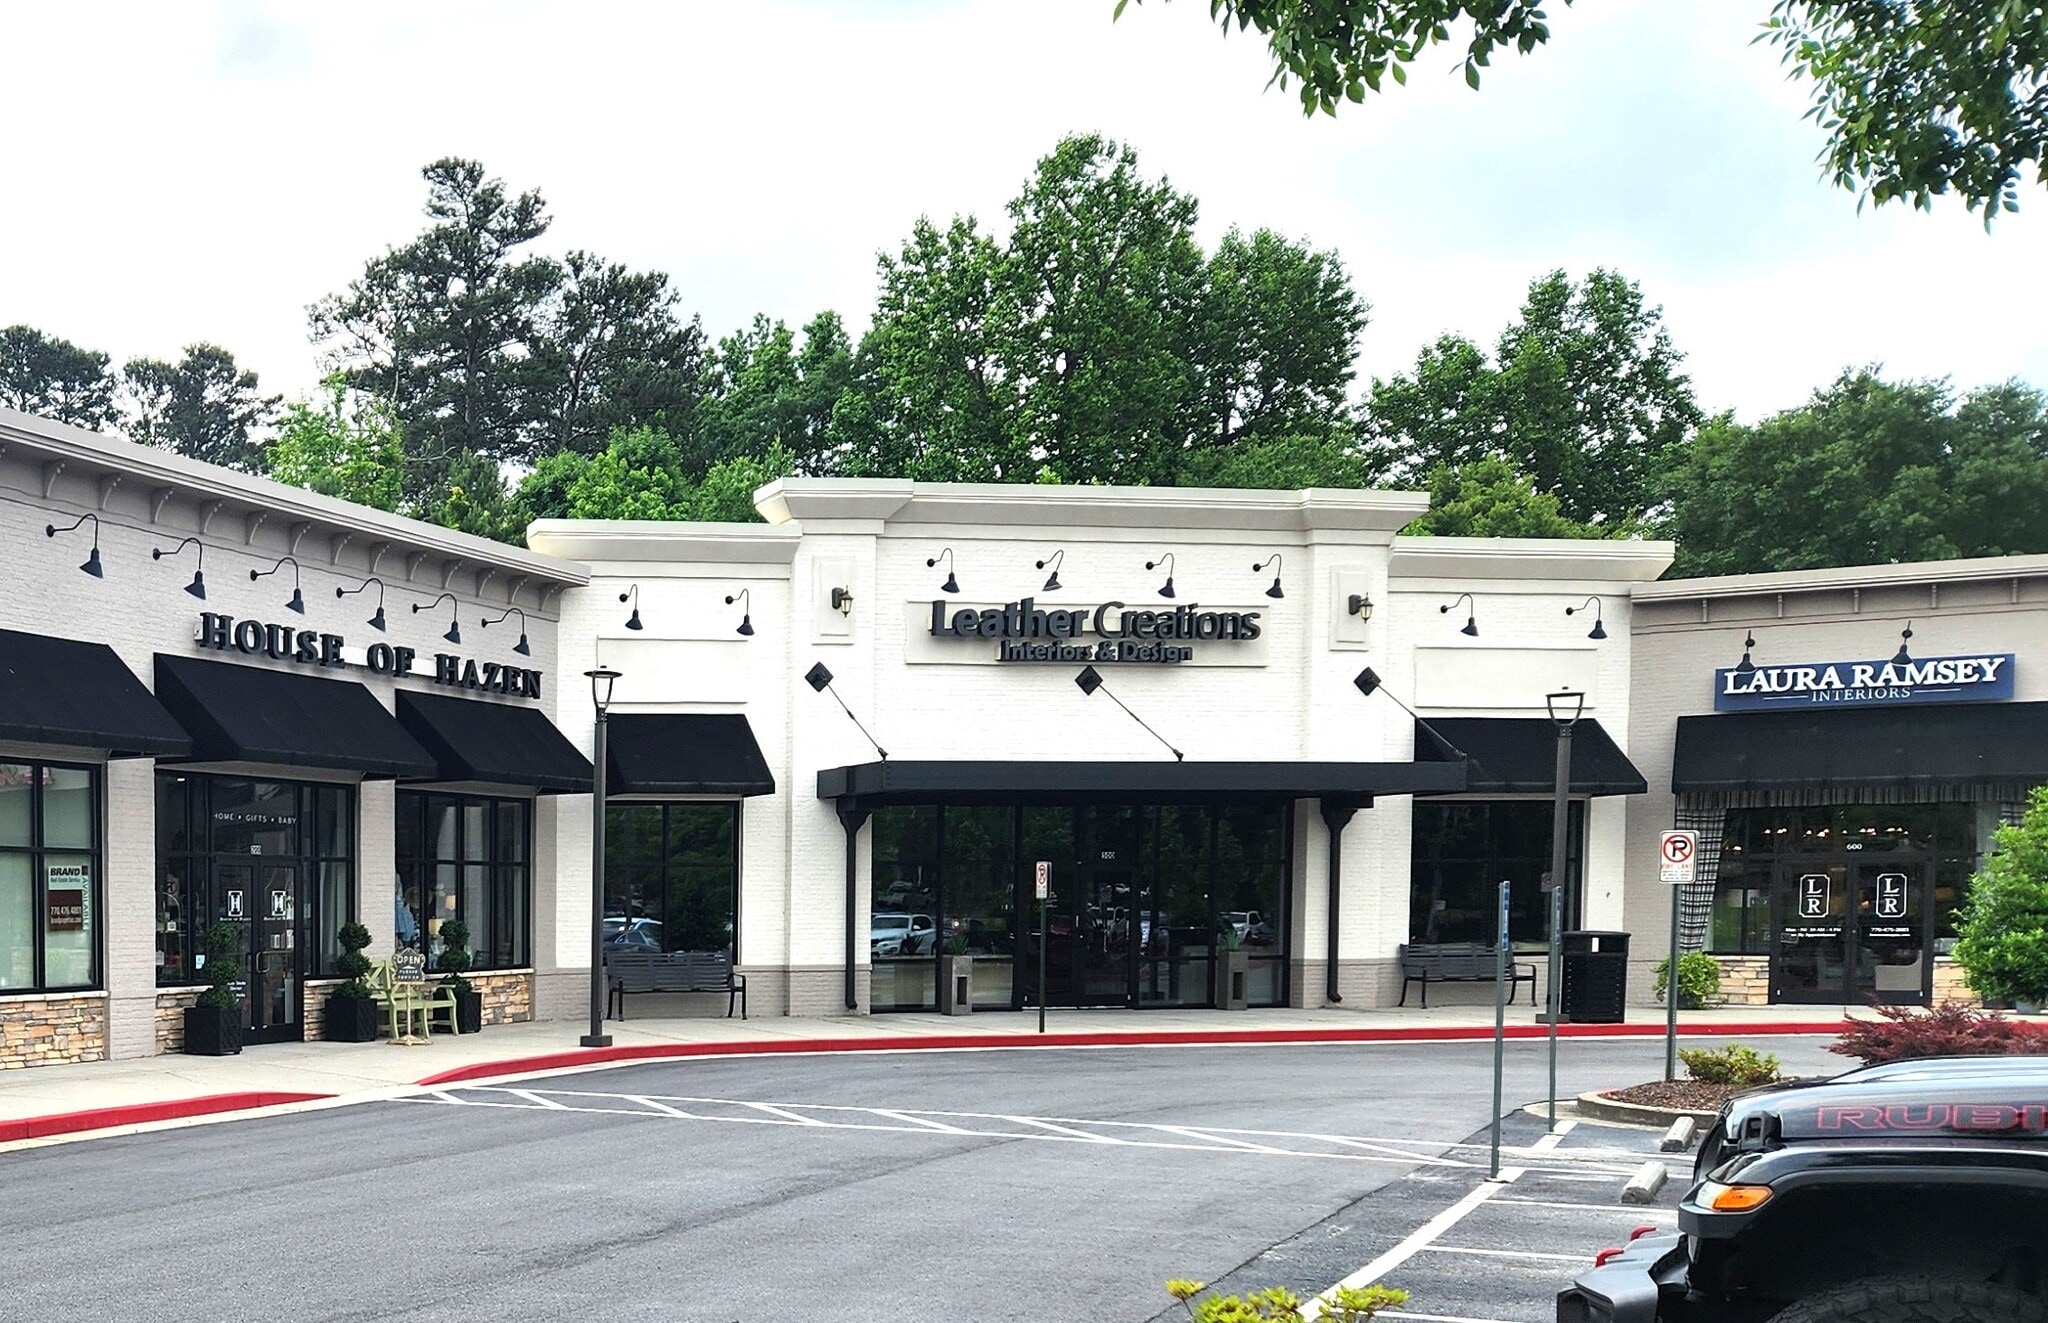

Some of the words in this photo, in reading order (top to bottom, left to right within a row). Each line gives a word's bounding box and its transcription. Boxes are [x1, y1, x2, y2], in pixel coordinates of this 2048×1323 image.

[931, 597, 1089, 637] Leather
[1093, 601, 1261, 640] Creations
[200, 612, 345, 669] HOUSE
[367, 643, 415, 677] OF
[434, 653, 542, 699] HAZEN
[999, 640, 1093, 661] Interiors
[1095, 640, 1117, 661] &
[1117, 640, 1193, 664] Design
[1723, 665, 1844, 694] LAURA
[1851, 657, 2005, 689] RAMSEY
[1812, 686, 1911, 702] INTERIORS
[245, 814, 267, 823] GIFTS
[278, 816, 297, 824] BABY
[50, 867, 81, 876] BRAND
[1807, 878, 1822, 894] L
[1884, 877, 1899, 893] L
[1807, 898, 1821, 914] R
[1883, 897, 1898, 913] R
[396, 955, 420, 965] OPEN
